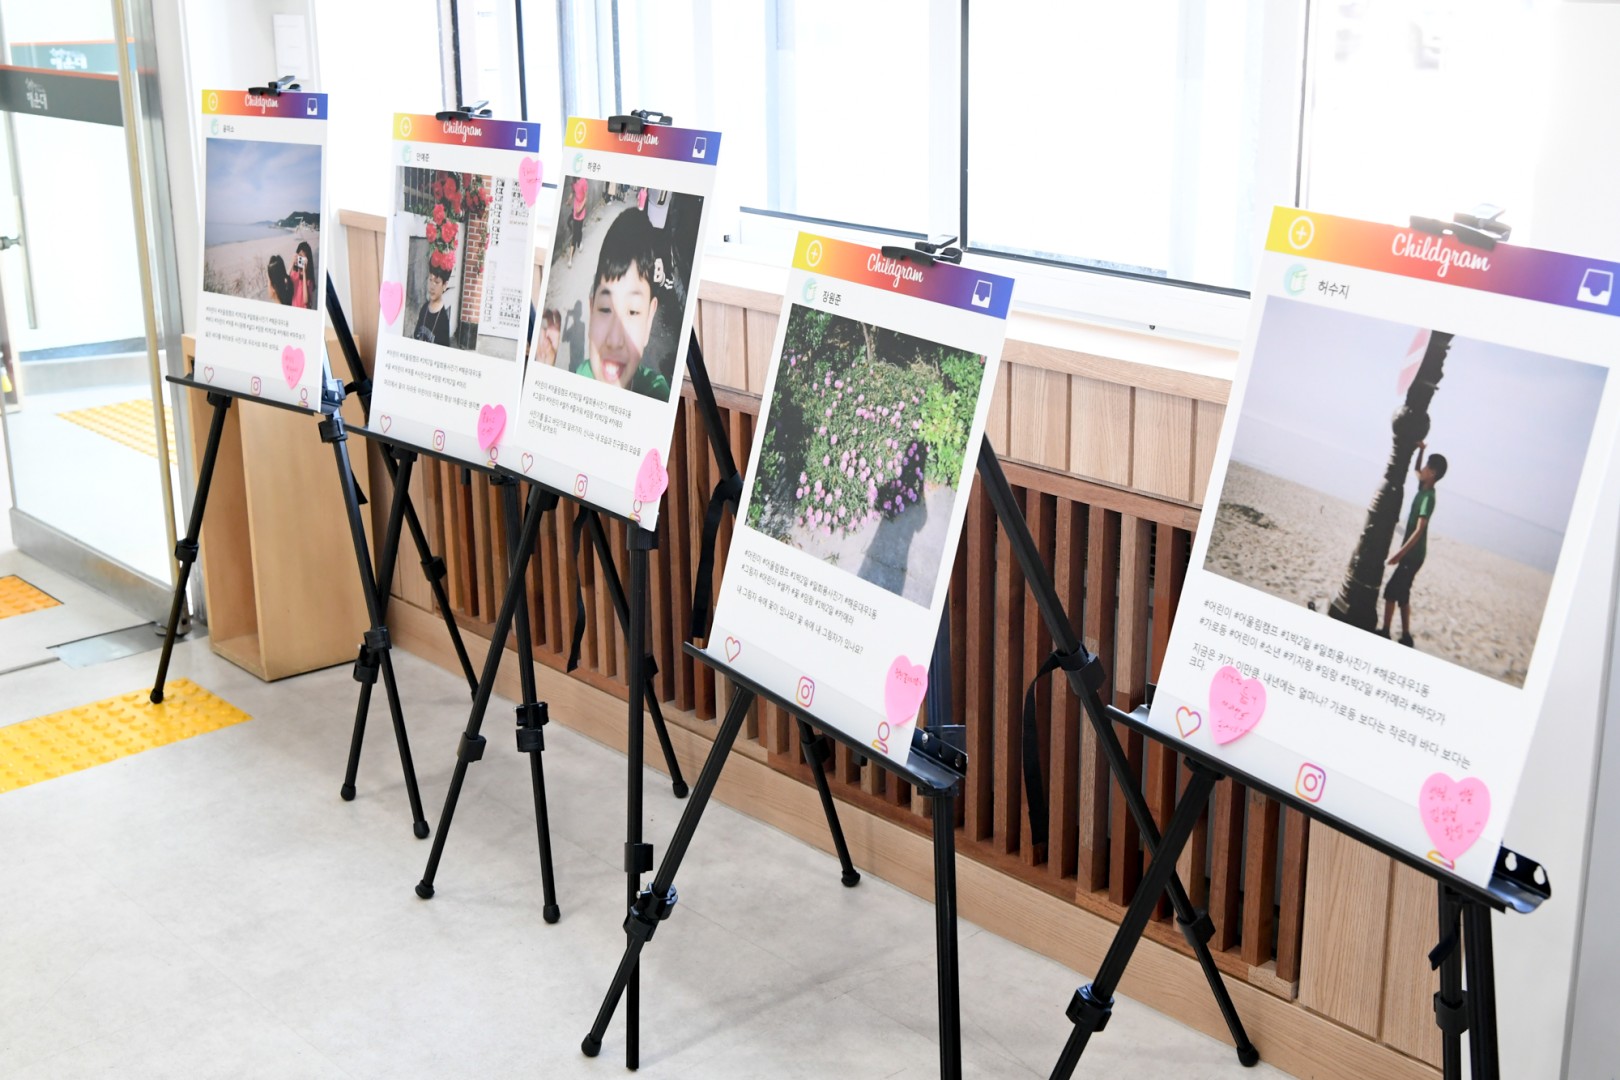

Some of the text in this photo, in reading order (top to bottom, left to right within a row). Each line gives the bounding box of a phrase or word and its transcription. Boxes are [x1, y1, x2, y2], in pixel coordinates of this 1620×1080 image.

[244, 94, 279, 114] Childgram
[443, 120, 482, 143] Childgram
[867, 253, 924, 288] Childgram
[1391, 233, 1491, 277] Childgram
[822, 290, 842, 306] 장원준
[1317, 279, 1350, 299] 허수지
[1204, 600, 1430, 698] #어린이 #어울림캠프 #1박2일 #일회용사진기 #해운대우1동
[1199, 617, 1445, 725] #가로등 #어린이 #소년 #키자랑 #임랑 #1박2일 #카메라 #바닷가
[1192, 642, 1216, 661] 지금은
[1217, 653, 1234, 665] 키가
[1263, 673, 1296, 696] 내년에는
[1298, 687, 1329, 707] 얼마나?
[1330, 700, 1356, 721] 가로등
[1358, 714, 1386, 734] 보다는
[1389, 725, 1417, 747] 작은데
[1419, 738, 1439, 756] 바다
[1441, 749, 1471, 770] 보다는
